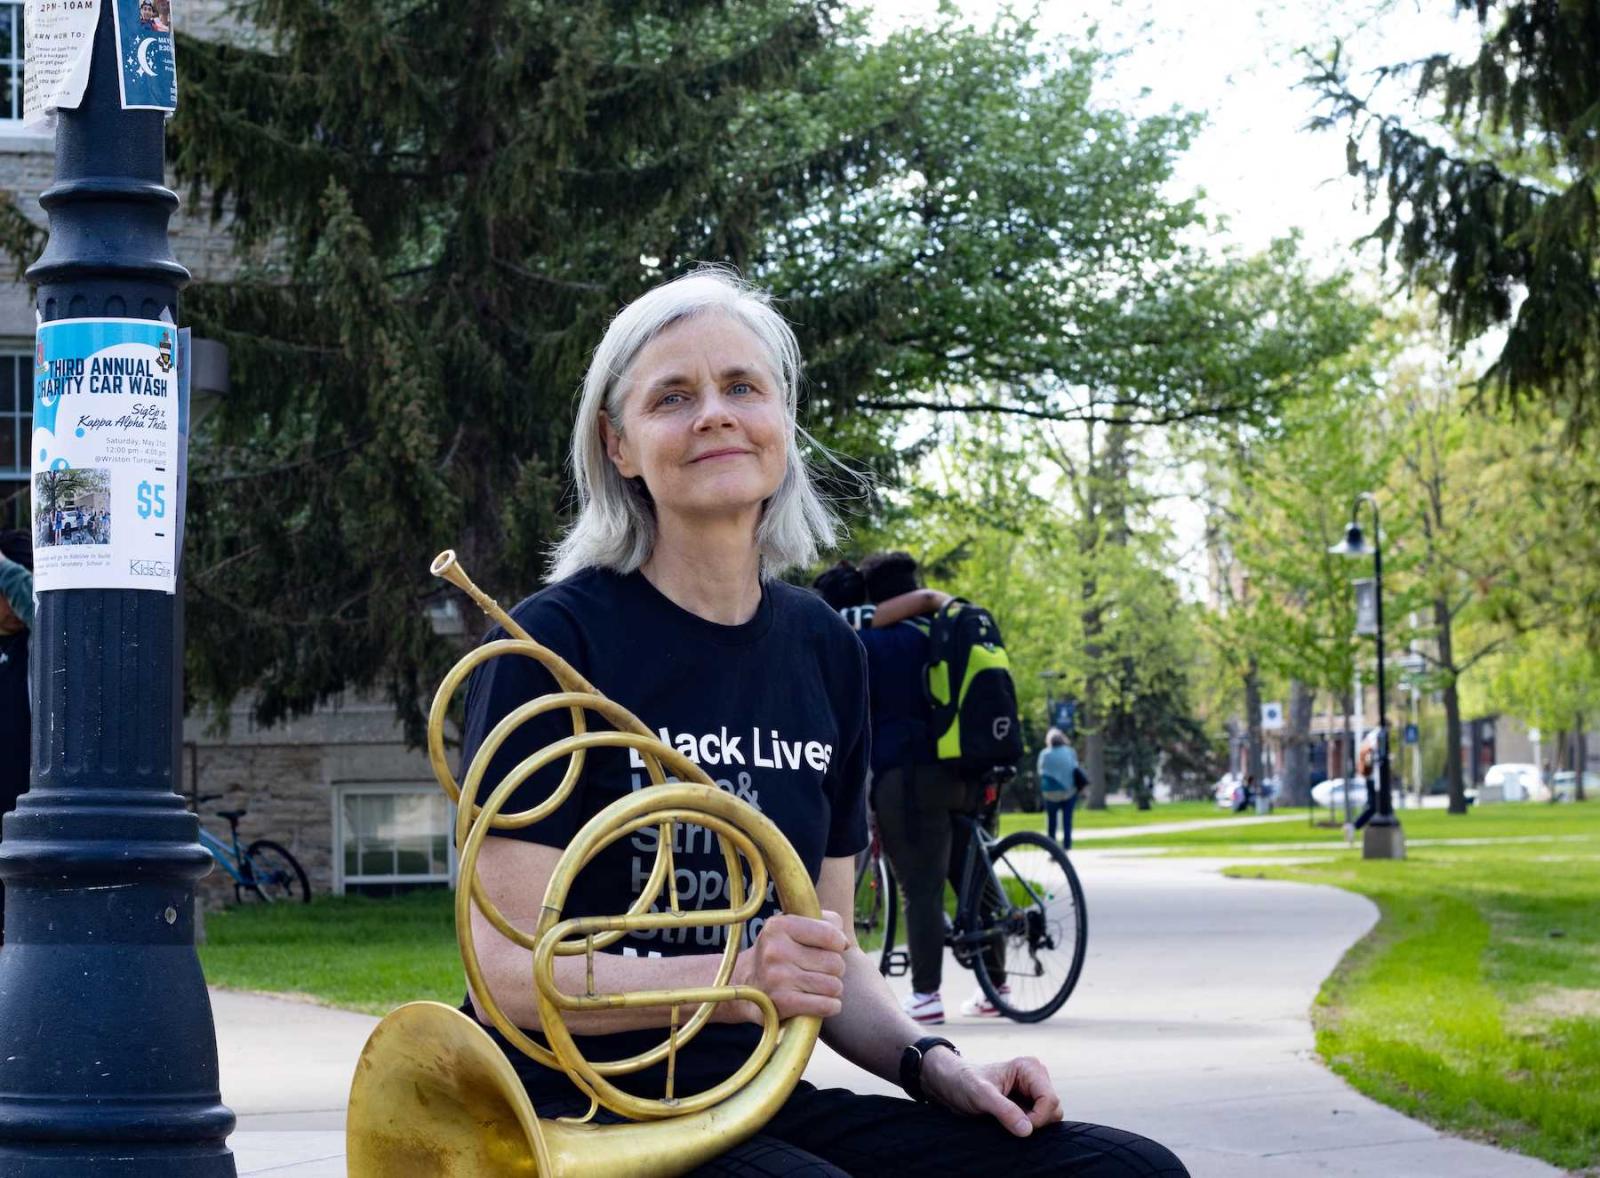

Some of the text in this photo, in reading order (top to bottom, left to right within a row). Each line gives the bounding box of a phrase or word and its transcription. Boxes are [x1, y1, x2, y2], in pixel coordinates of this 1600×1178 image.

[49, 357, 154, 378] THIRD ANNUAL
[89, 376, 122, 394] CAR
[129, 377, 167, 397] WASH
[77, 415, 113, 430] Kappa
[114, 416, 145, 430] Alpha
[137, 480, 165, 519] $5
[753, 727, 832, 774] Lives
